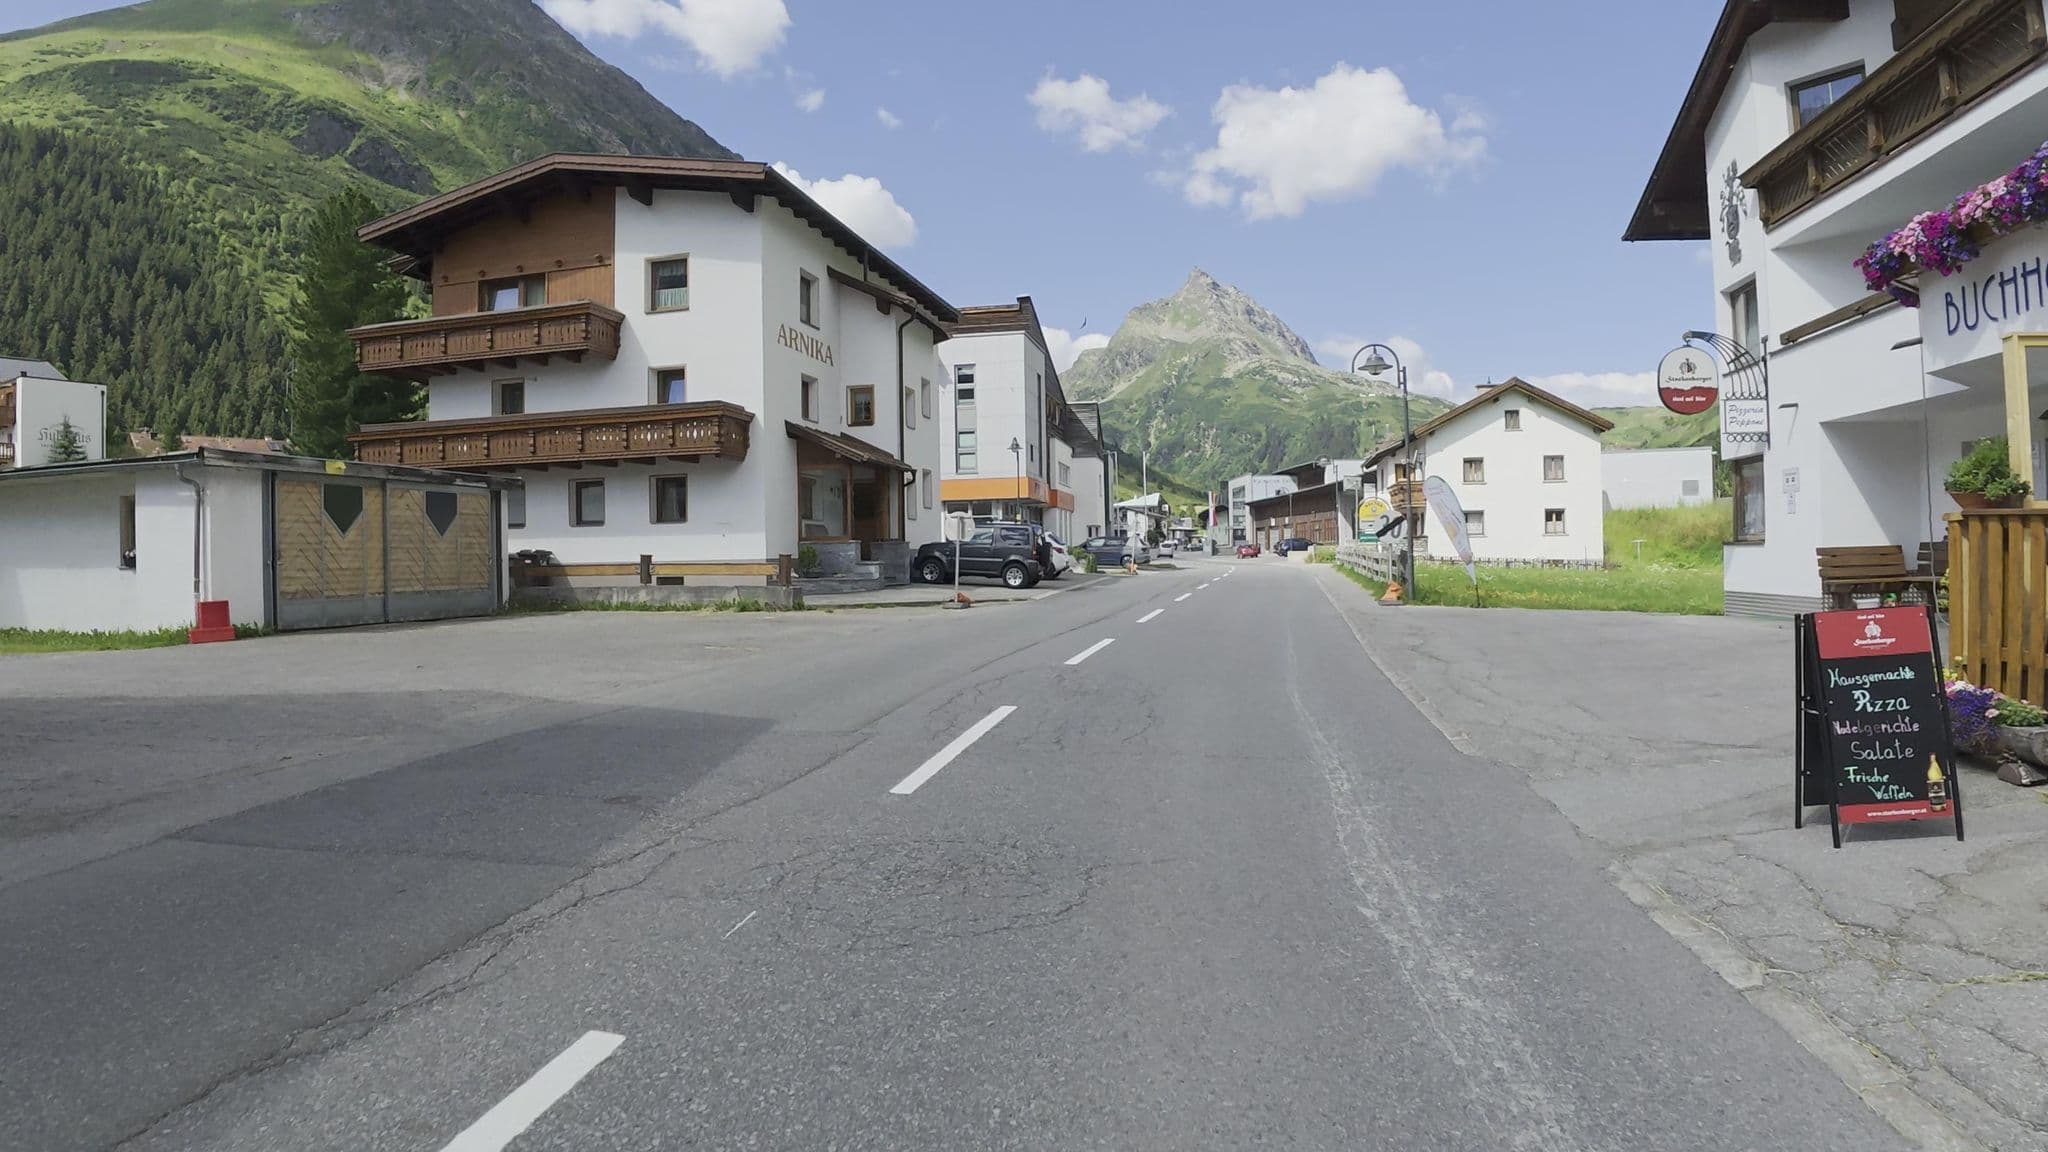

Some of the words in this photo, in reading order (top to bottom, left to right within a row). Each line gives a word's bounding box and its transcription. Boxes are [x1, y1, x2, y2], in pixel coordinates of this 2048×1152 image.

[1945, 256, 2048, 336] BUCHH
[777, 323, 834, 367] ARNIKA
[1828, 666, 1916, 688] Hausgemachte
[1852, 690, 1911, 713] Pizza
[1851, 739, 1915, 760] Salate
[1844, 766, 1890, 783] Frische
[1867, 784, 1914, 800] Waffeln
